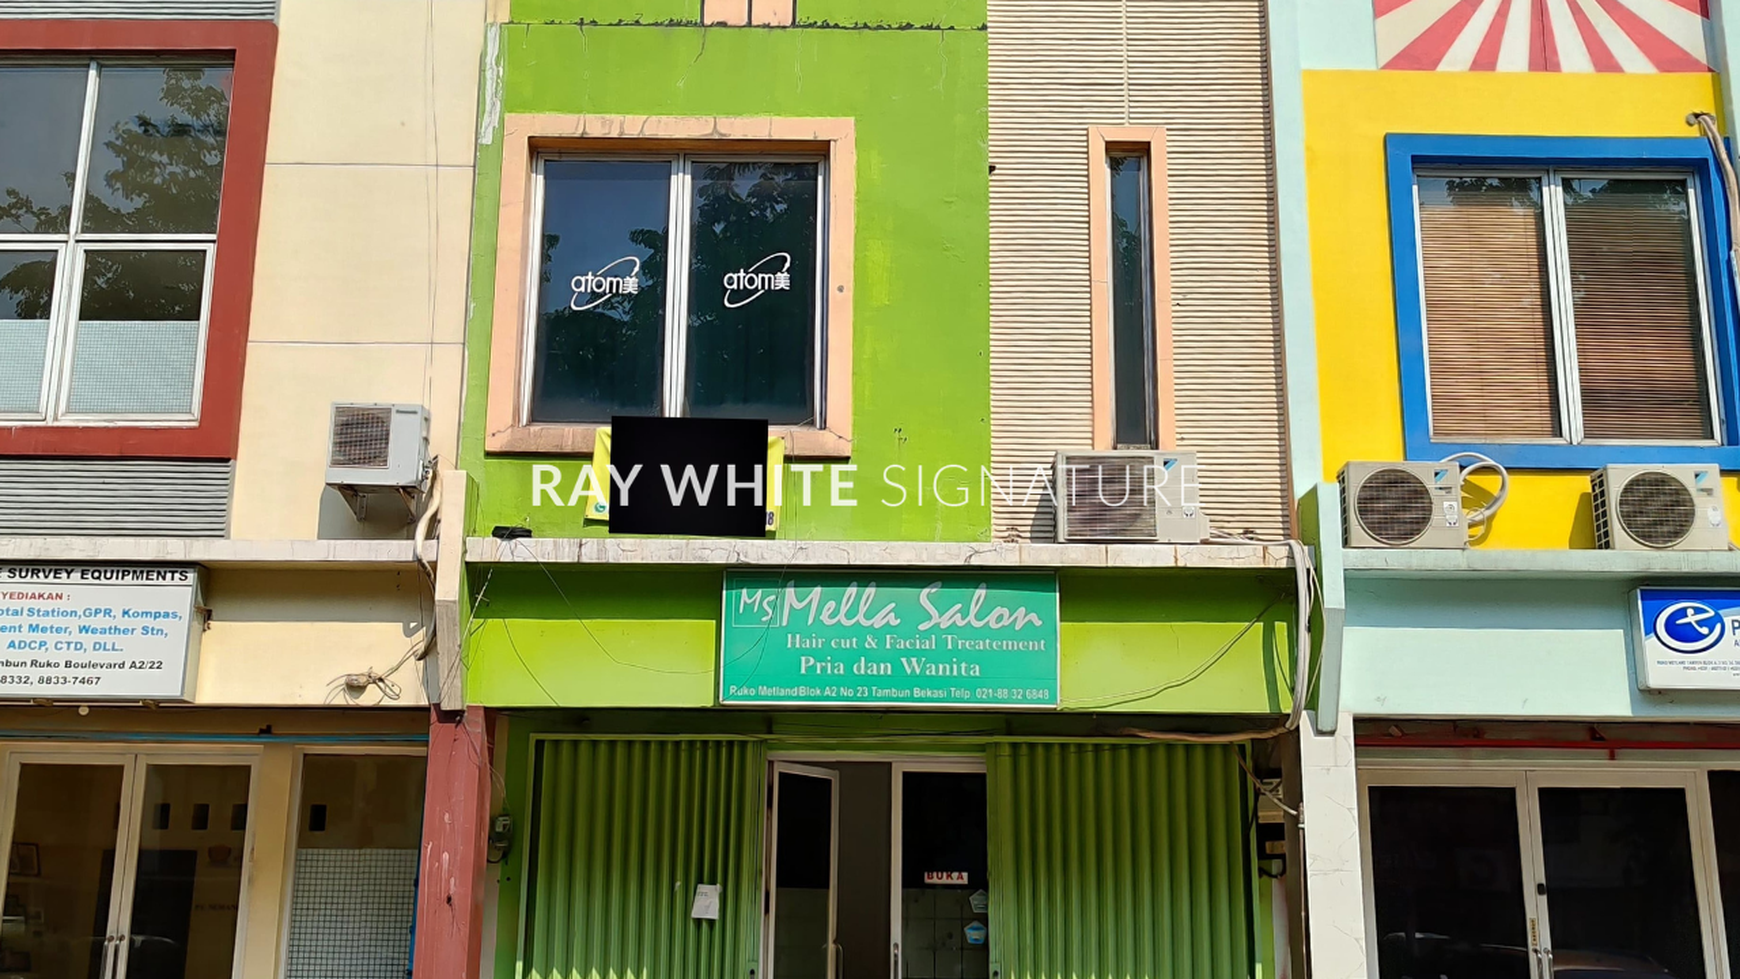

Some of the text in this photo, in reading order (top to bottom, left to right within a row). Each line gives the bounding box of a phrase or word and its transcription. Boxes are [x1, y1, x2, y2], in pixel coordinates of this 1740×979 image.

[7, 567, 189, 581] SURVEY EQUIPMENTS
[1, 591, 63, 601] YEDIAKAN
[781, 580, 901, 628] Mella
[917, 581, 1043, 631] Salon
[121, 608, 183, 621] Kompas,
[28, 624, 73, 635] Meter,
[78, 625, 136, 636] Weather
[141, 626, 169, 638] Stn,
[6, 640, 124, 653] ADCP, CTD, DLL.
[787, 634, 1046, 651] Hair cut & Facial Treatement
[30, 659, 60, 669] Ruko
[64, 660, 125, 670] Boulevard
[128, 661, 164, 671] A2/22
[800, 656, 981, 677] Pria dan Wanita
[37, 675, 101, 686] 8833-7467
[729, 685, 756, 696] Ruko
[823, 686, 838, 697] A2
[840, 687, 854, 697] No
[857, 687, 869, 697] 23
[872, 687, 910, 698] Tambun
[913, 688, 947, 699] Bekasi
[975, 688, 1008, 700] 021-88
[1011, 689, 1023, 700] 32
[1026, 689, 1049, 700] 6848
[926, 871, 965, 881] BUKA
